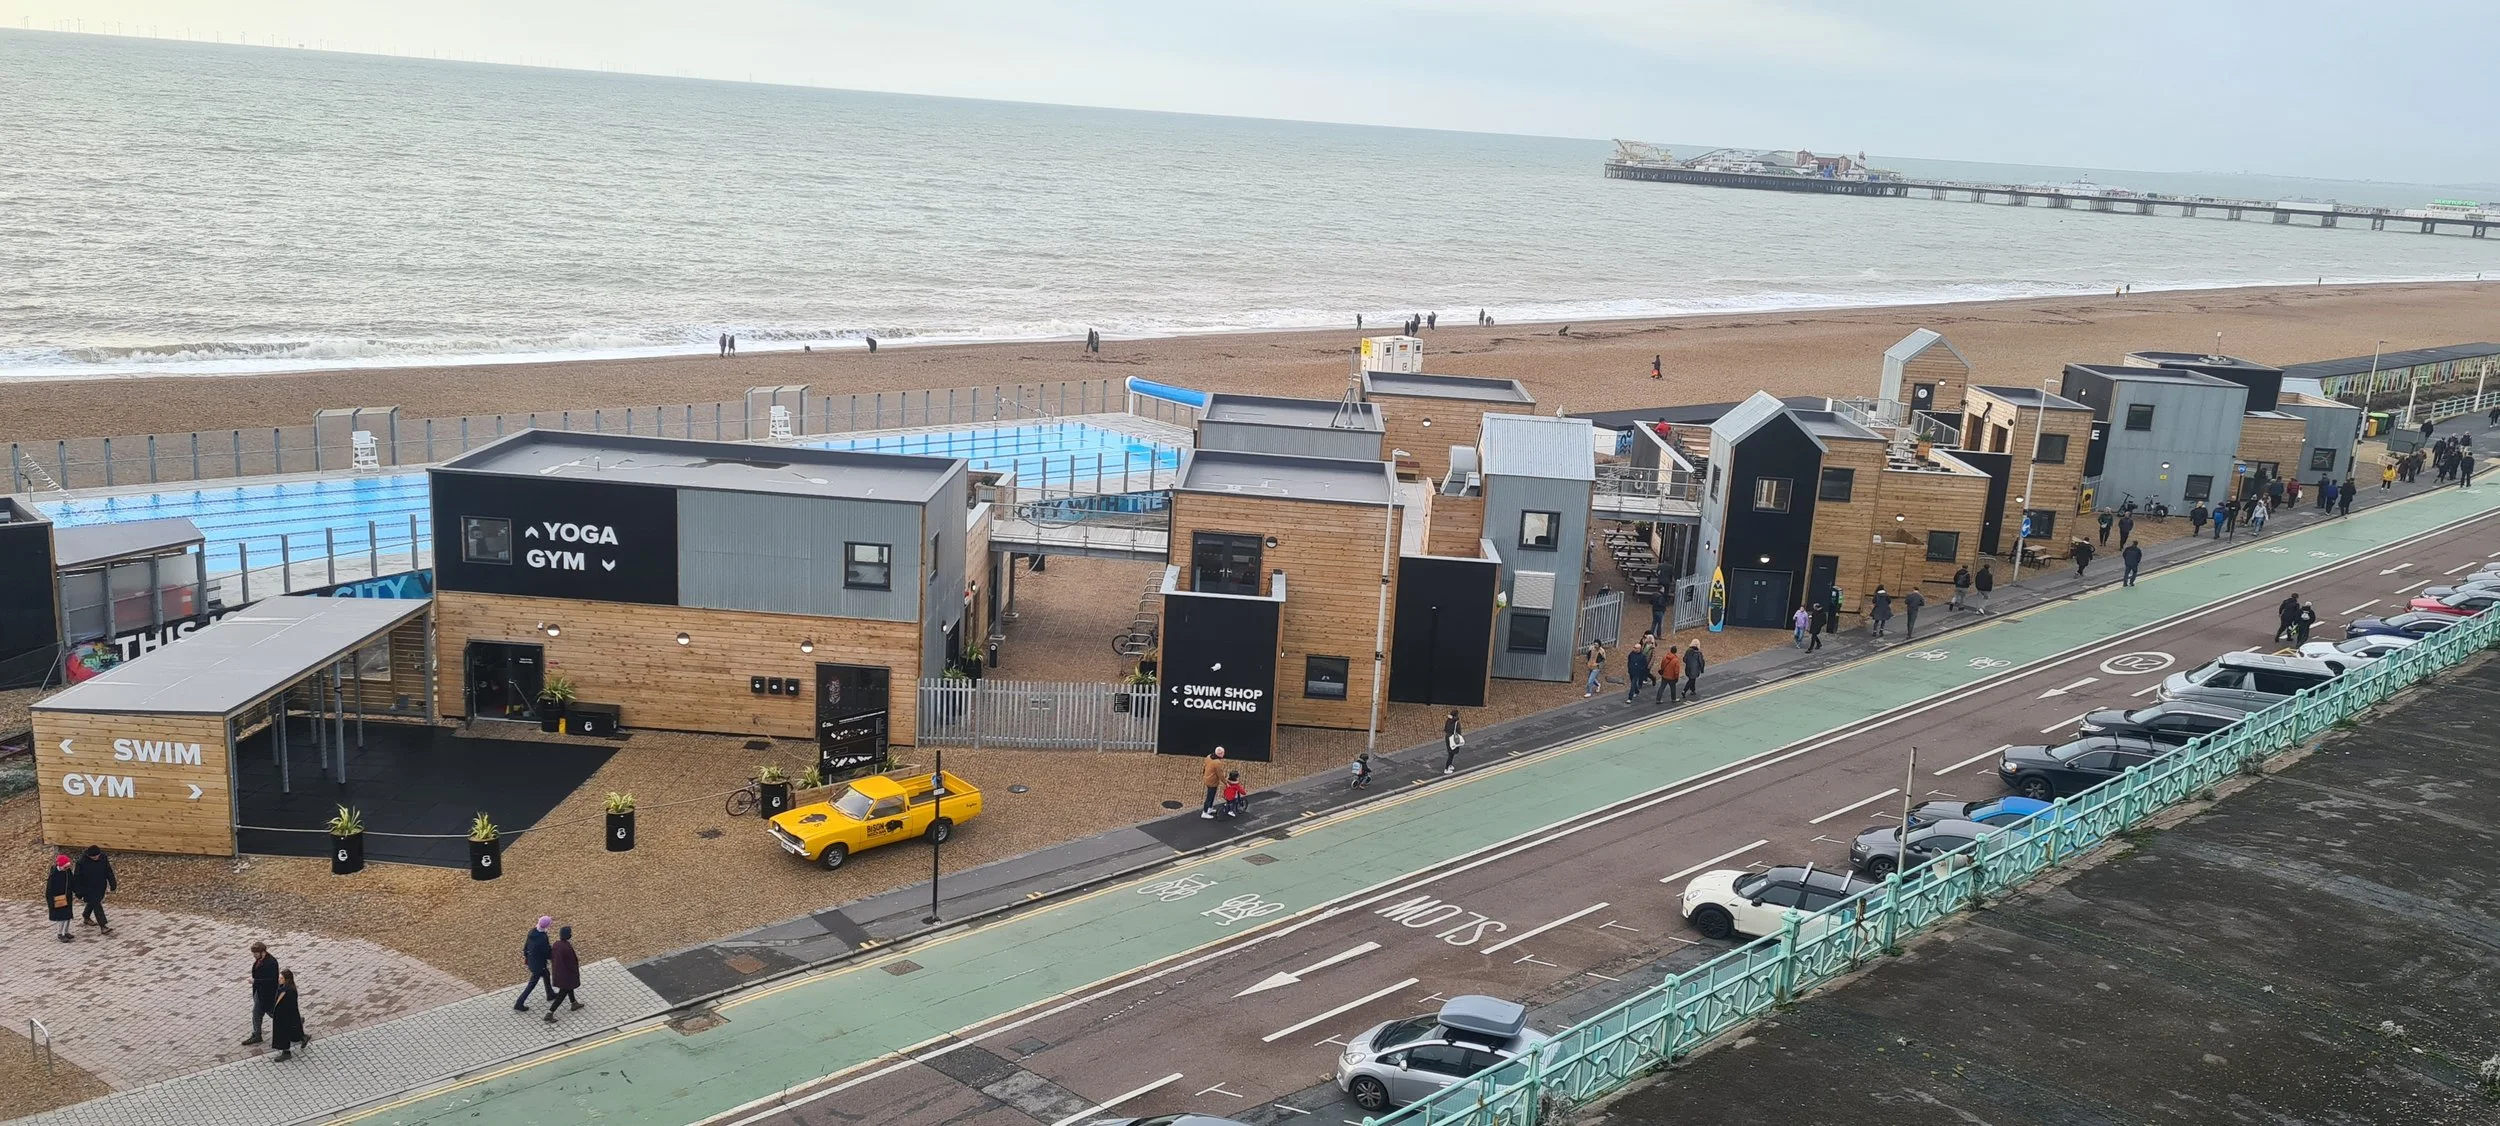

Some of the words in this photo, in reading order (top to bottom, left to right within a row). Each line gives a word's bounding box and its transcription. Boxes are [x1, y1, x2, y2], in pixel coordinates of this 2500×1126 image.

[543, 522, 619, 545] YOGA
[526, 549, 585, 571] GYM
[2114, 656, 2164, 669] 20
[1183, 685, 1221, 697] SWIM
[1224, 687, 1263, 700] SHOP
[1183, 698, 1257, 712] COACHING
[113, 738, 201, 765] SWIM
[62, 773, 135, 798] GYM
[1374, 895, 1507, 946] SLOW
